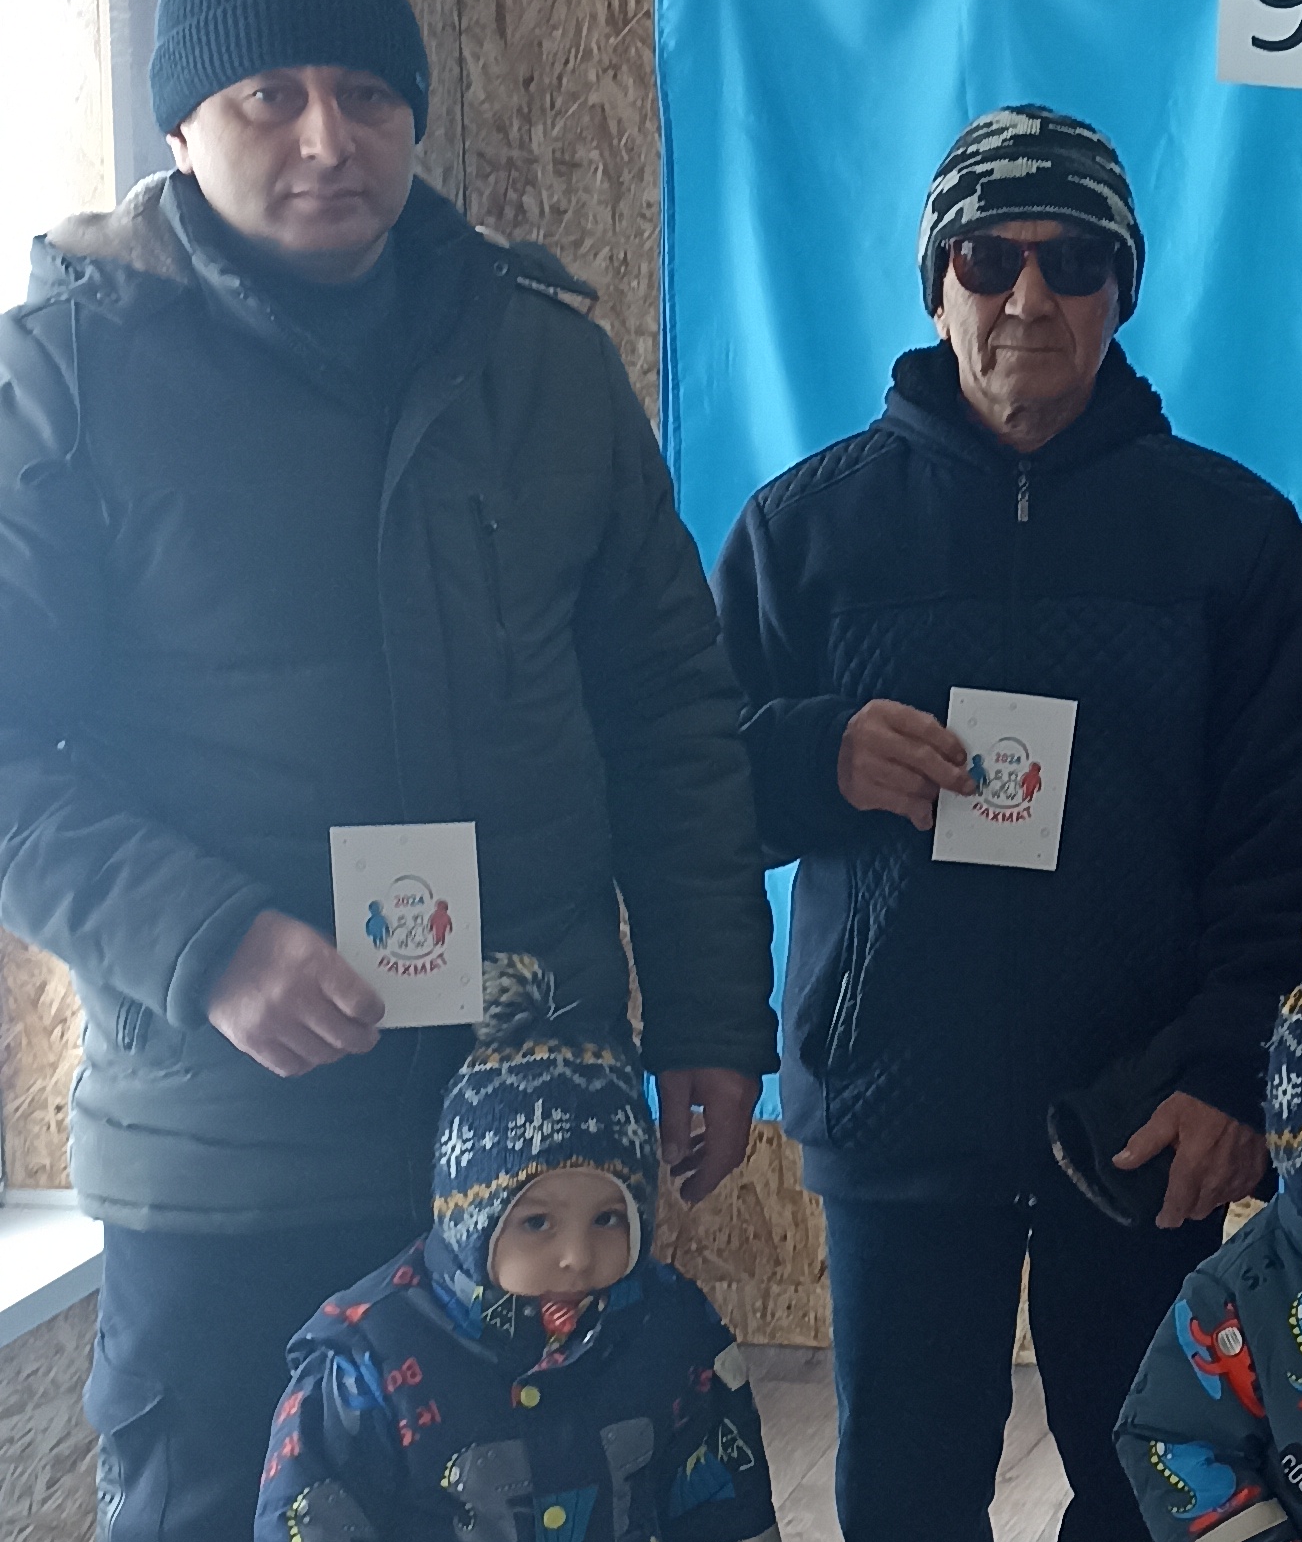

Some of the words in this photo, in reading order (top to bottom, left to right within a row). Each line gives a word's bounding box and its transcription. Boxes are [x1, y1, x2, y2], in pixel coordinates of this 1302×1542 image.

[995, 752, 1022, 765] 2024
[972, 802, 1032, 823] РАХМАТ
[394, 895, 425, 908] 2024
[376, 952, 448, 977] РАХМАТ
